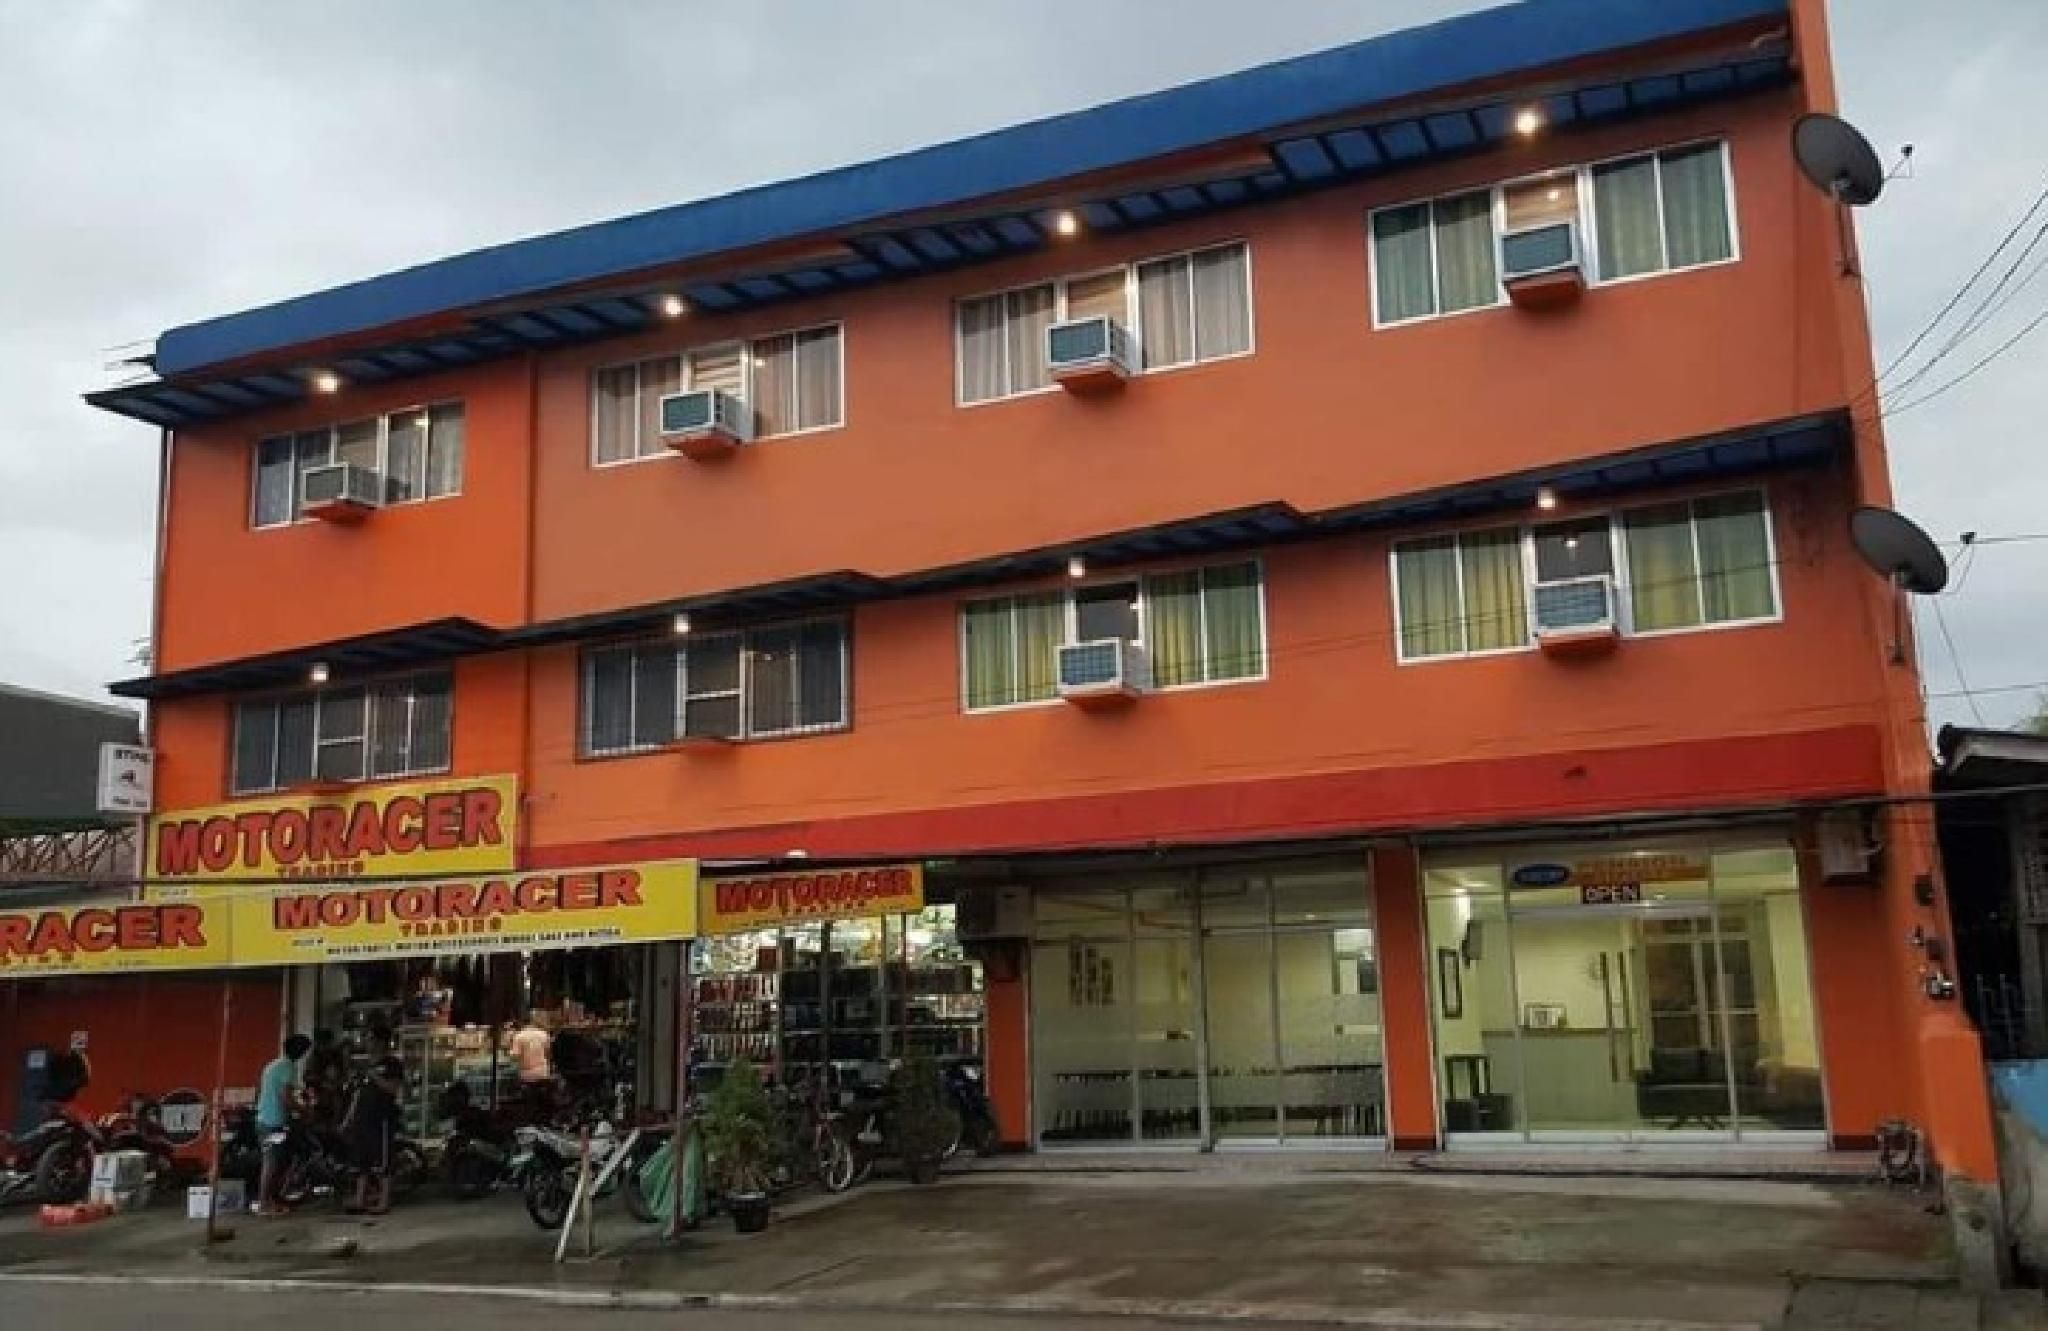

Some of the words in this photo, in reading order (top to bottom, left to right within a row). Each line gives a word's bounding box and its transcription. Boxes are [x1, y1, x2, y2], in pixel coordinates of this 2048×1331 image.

[158, 787, 502, 875] MOTORACER
[277, 860, 364, 878] TRADING
[274, 868, 642, 929] MOTORACER
[716, 869, 913, 914] MOTORACER
[1586, 885, 1638, 901] OPEN
[399, 916, 502, 938] TRADING
